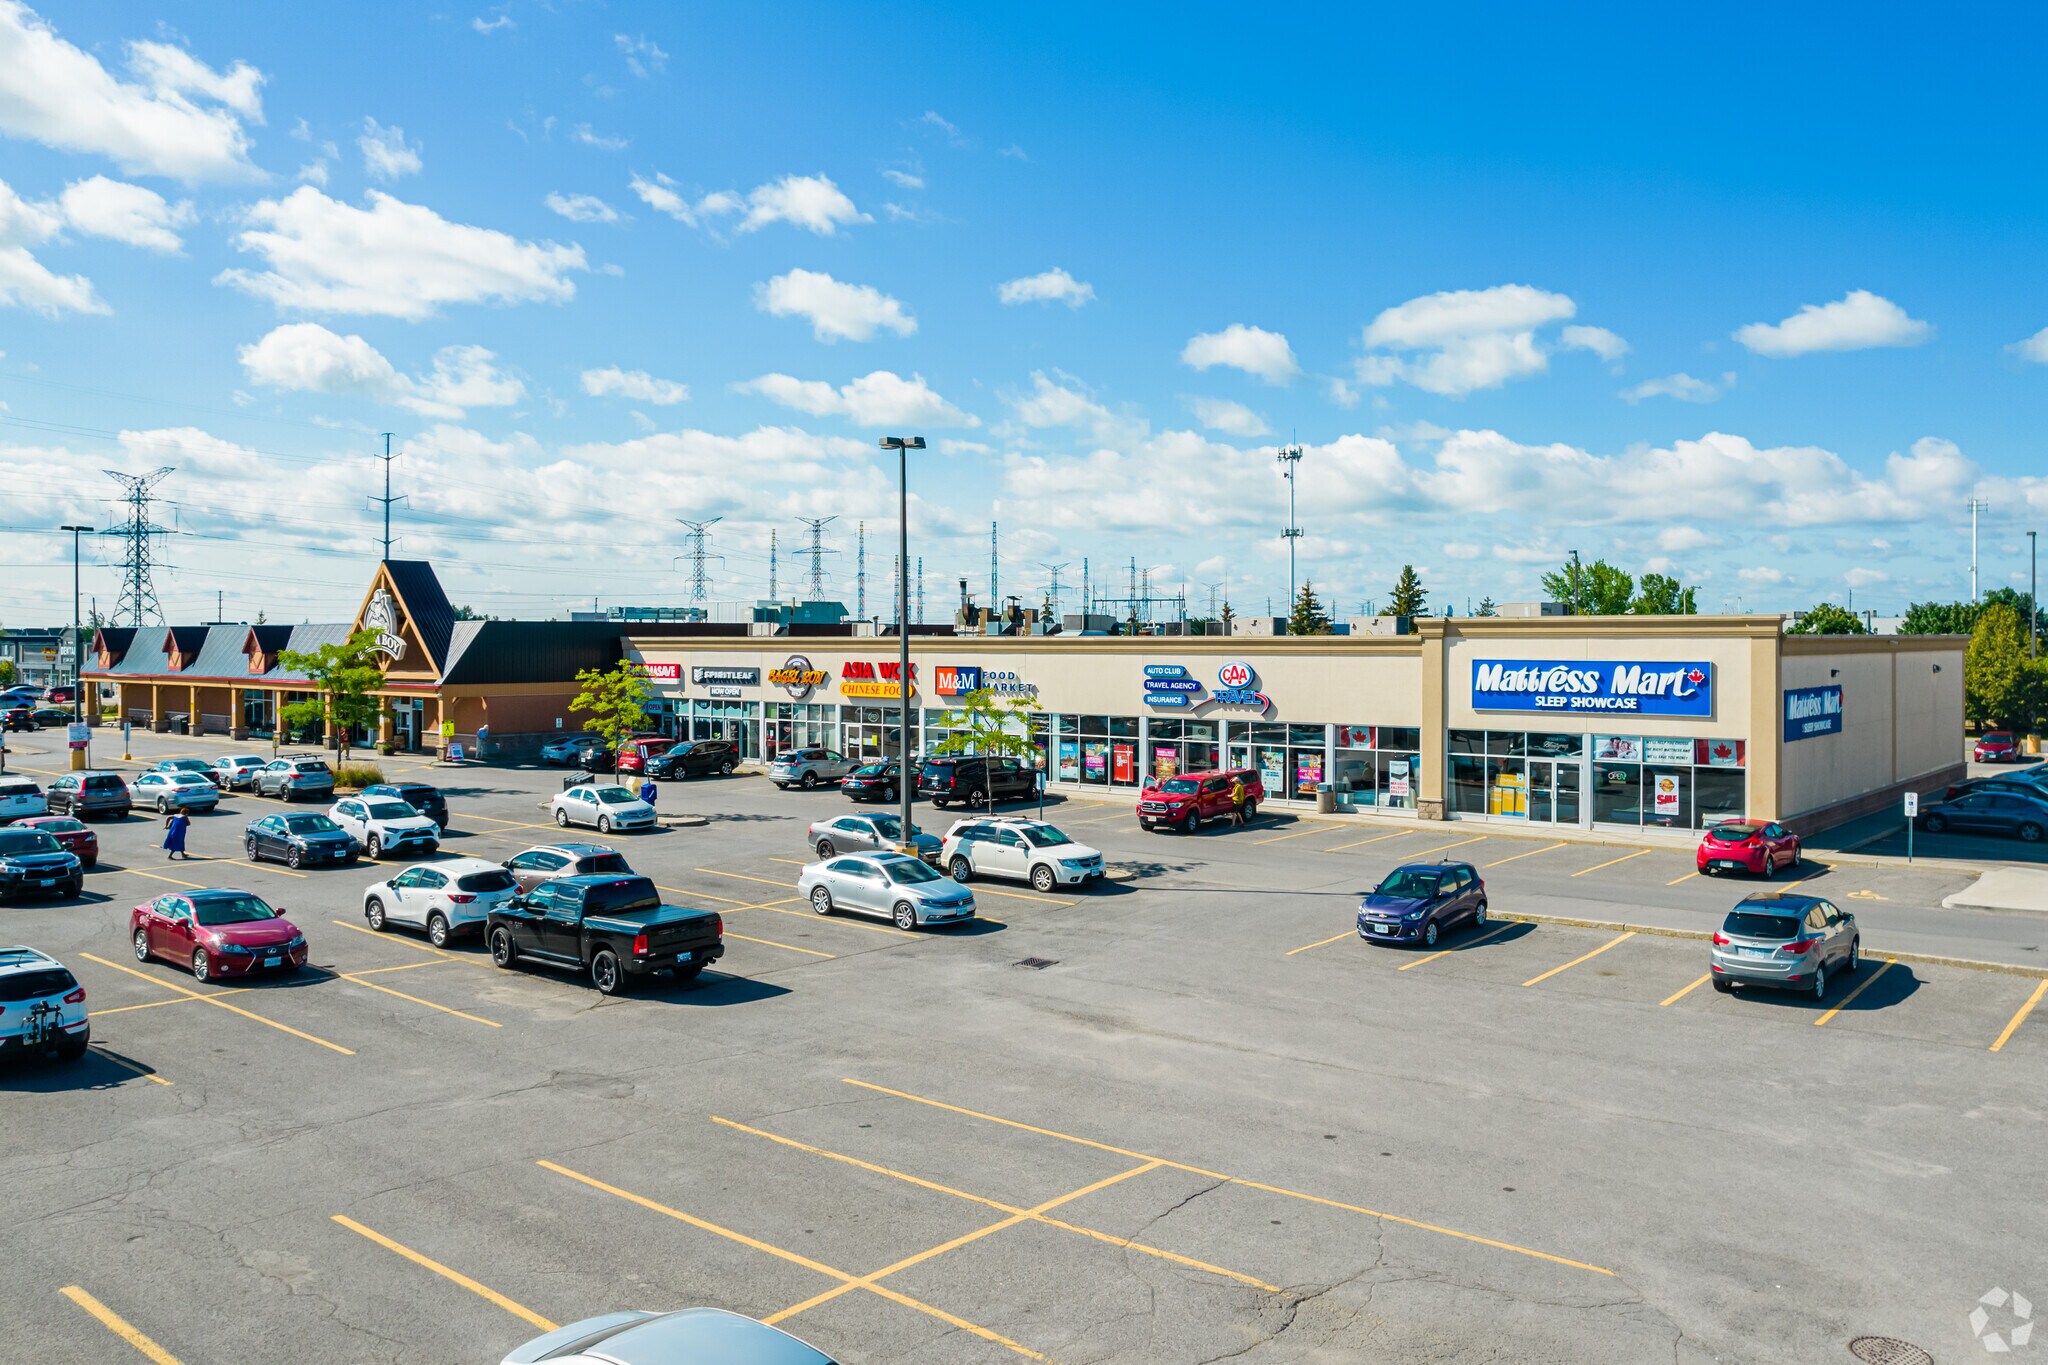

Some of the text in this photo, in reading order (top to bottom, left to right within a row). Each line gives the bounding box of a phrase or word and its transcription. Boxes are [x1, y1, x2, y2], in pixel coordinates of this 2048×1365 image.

[381, 634, 400, 653] BOY
[704, 671, 753, 679] SPIRITLEAF
[768, 668, 826, 685] BAGEL RUN
[841, 662, 874, 678] ASIA
[982, 671, 1015, 680] FOOD
[1222, 666, 1248, 684] CAA
[938, 672, 975, 690] M&M
[1147, 681, 1196, 690] TRAVEL AGENCY
[1476, 664, 1696, 696] Mattress Mart
[842, 684, 901, 695] CHINESE FOO
[982, 683, 1033, 692] MARKET
[1147, 696, 1183, 704] INSURANCE
[1212, 690, 1261, 704] TRAVEL
[1535, 696, 1638, 709] SLEEP SHOWCASE
[1787, 691, 1842, 720] Mattress Mart
[1608, 771, 1627, 780] OPEN
[1656, 795, 1677, 805] SALE
